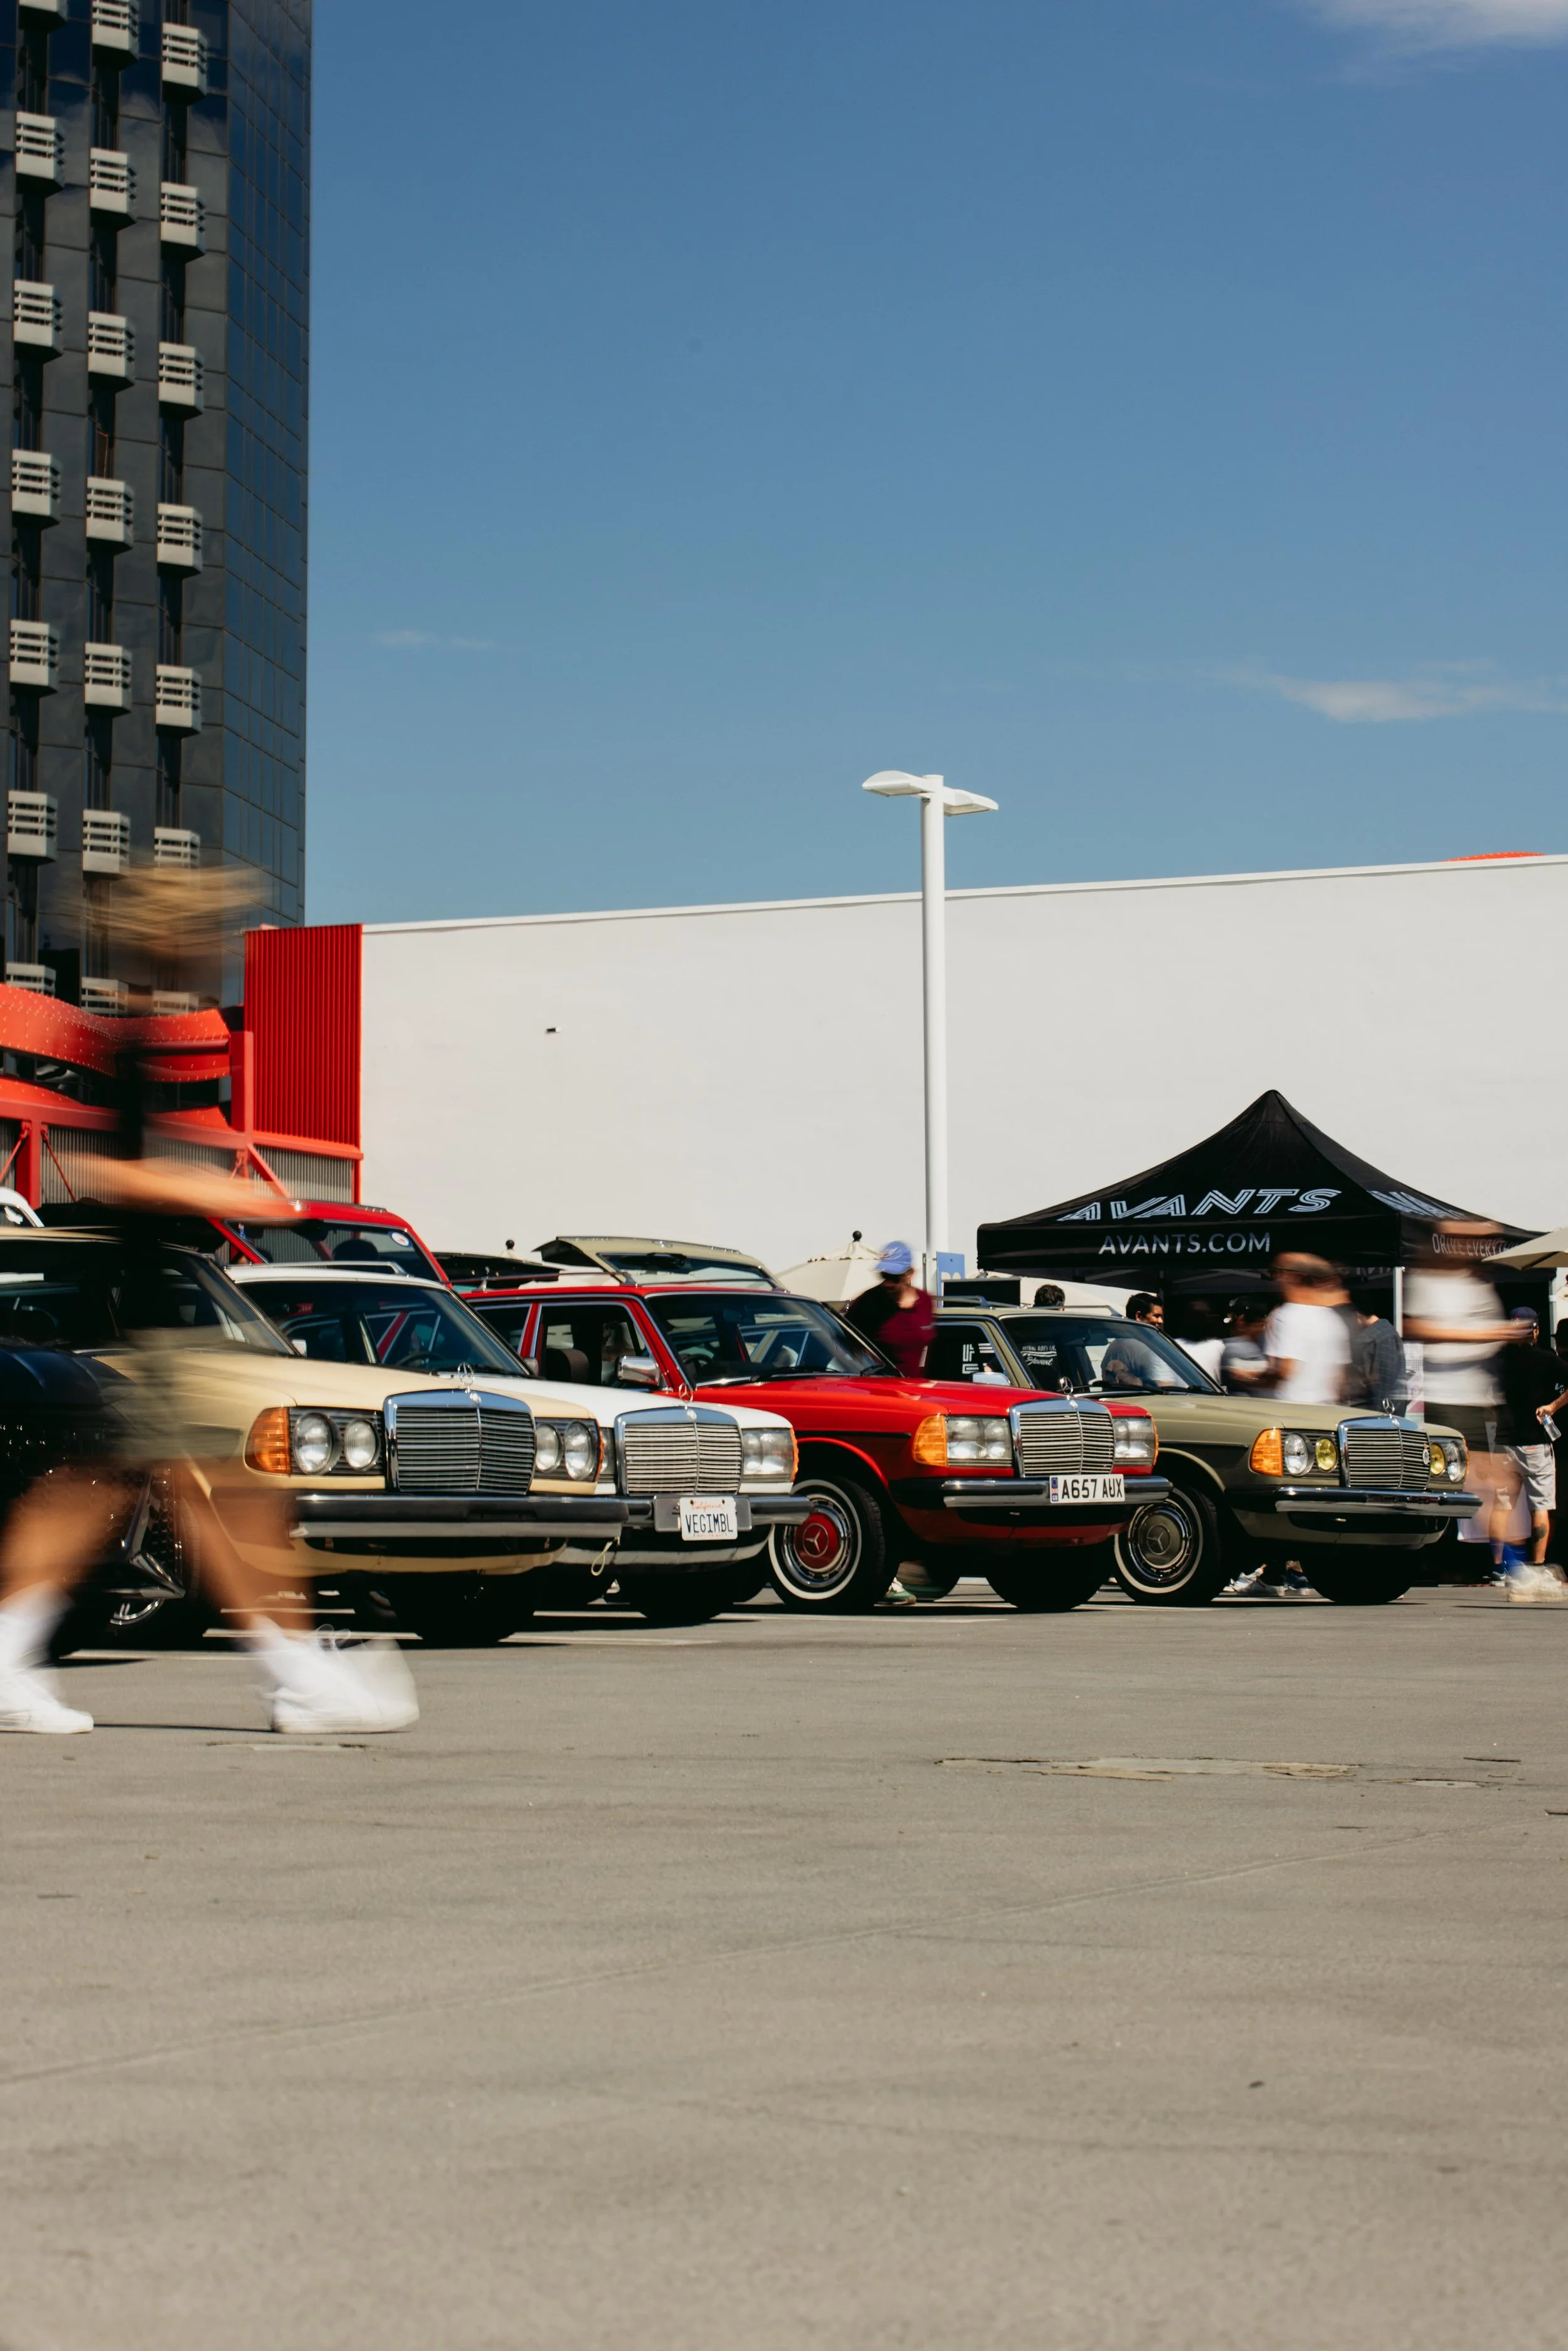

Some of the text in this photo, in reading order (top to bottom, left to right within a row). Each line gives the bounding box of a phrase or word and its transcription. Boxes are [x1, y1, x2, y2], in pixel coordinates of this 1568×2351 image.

[1056, 1188, 1343, 1222] AVANTS
[1098, 1232, 1271, 1255] AVANTS.COM
[1432, 1233, 1466, 1256] DRIVE
[1025, 1356, 1053, 1366] Stewart
[1061, 1478, 1123, 1499] A657 AUX
[685, 1514, 733, 1533] VEGIMBL
